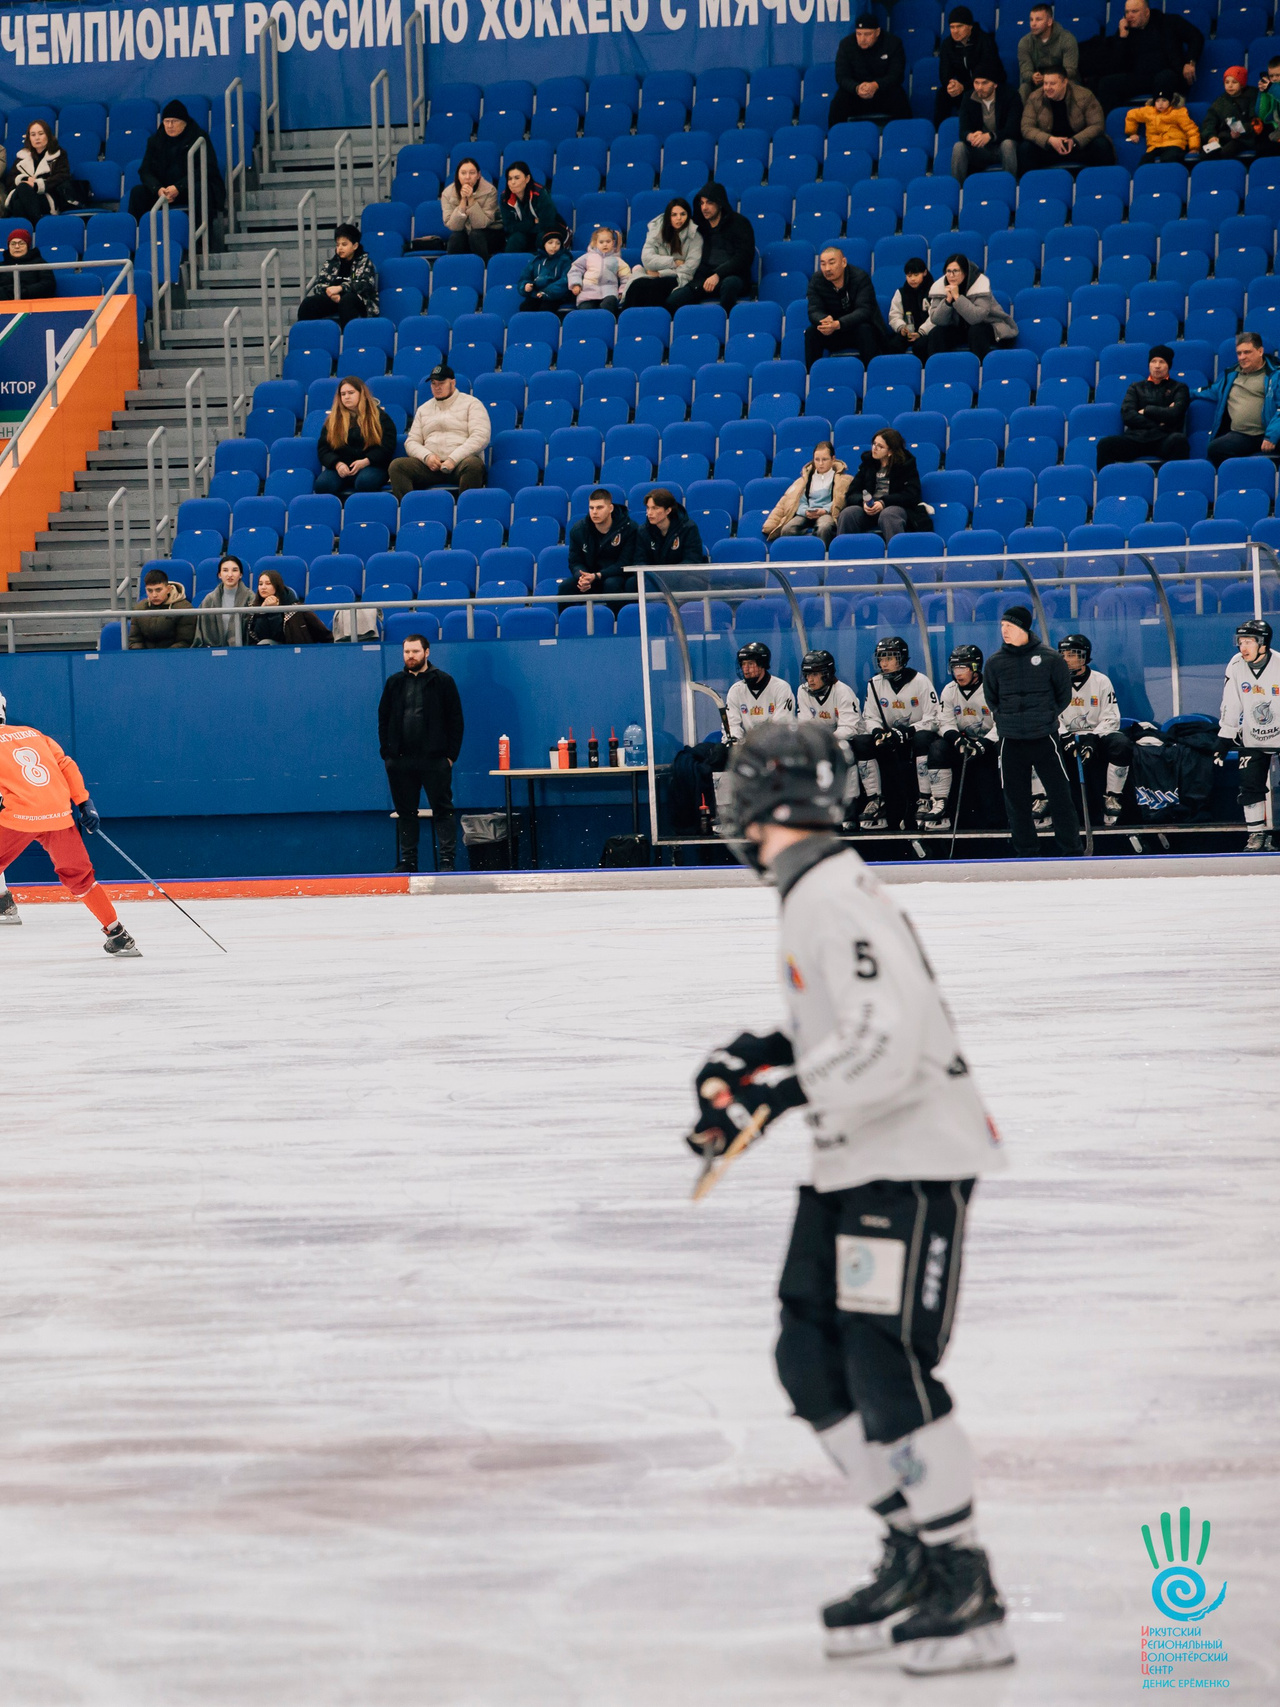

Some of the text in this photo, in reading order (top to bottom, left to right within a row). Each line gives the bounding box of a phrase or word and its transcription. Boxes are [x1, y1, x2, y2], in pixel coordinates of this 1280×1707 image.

[0, 4, 234, 66] ЧЕМПИОНАТ
[245, 0, 402, 55] РОССИИ
[477, 0, 648, 41] ХОККЕЮ
[658, 0, 687, 31] С
[12, 746, 51, 787] 8
[1238, 756, 1252, 770] 27
[852, 939, 879, 981] 5
